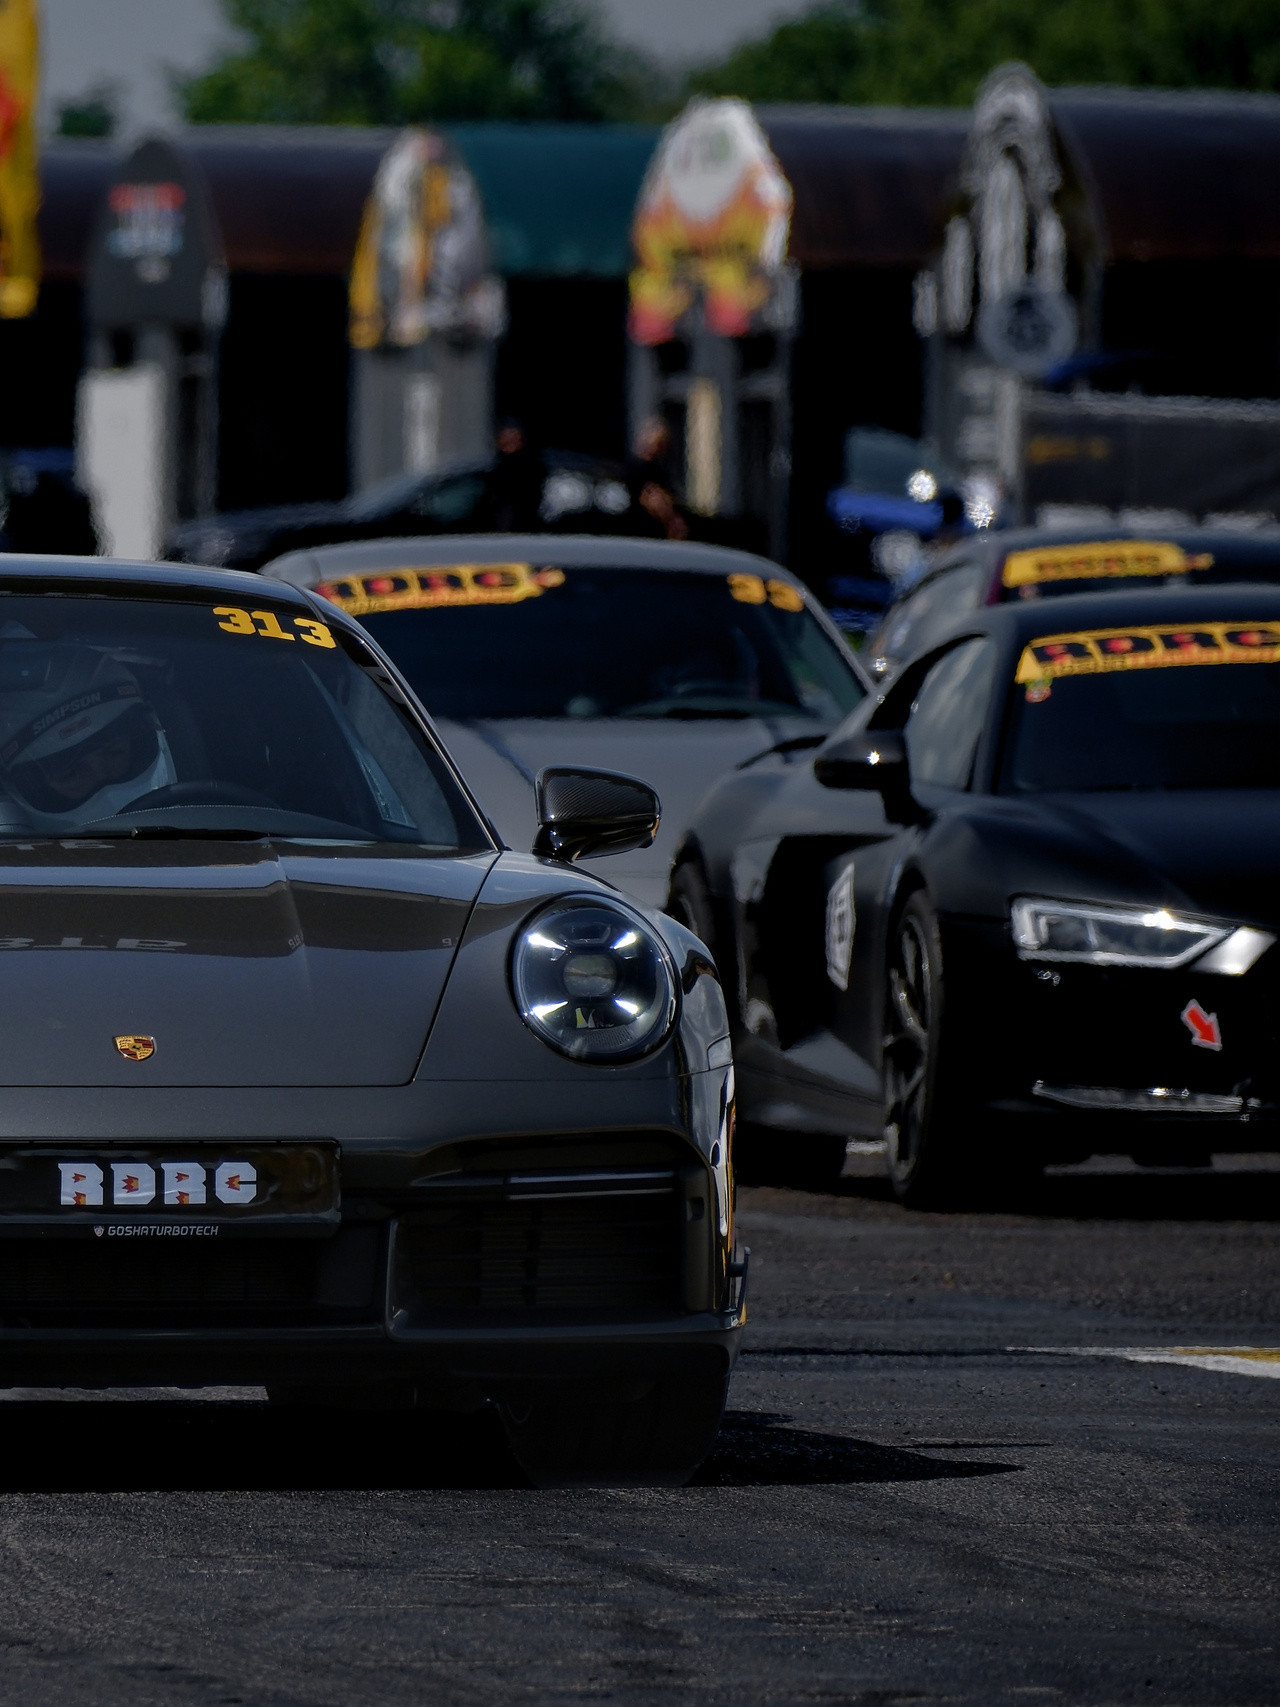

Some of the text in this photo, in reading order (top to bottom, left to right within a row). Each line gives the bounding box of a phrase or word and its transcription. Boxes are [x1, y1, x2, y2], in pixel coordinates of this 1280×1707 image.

[212, 606, 337, 649] 313
[33, 691, 101, 735] SIMPSON
[58, 1161, 258, 1206] RDRC
[107, 1225, 219, 1237] GOSHATURBOTECH
